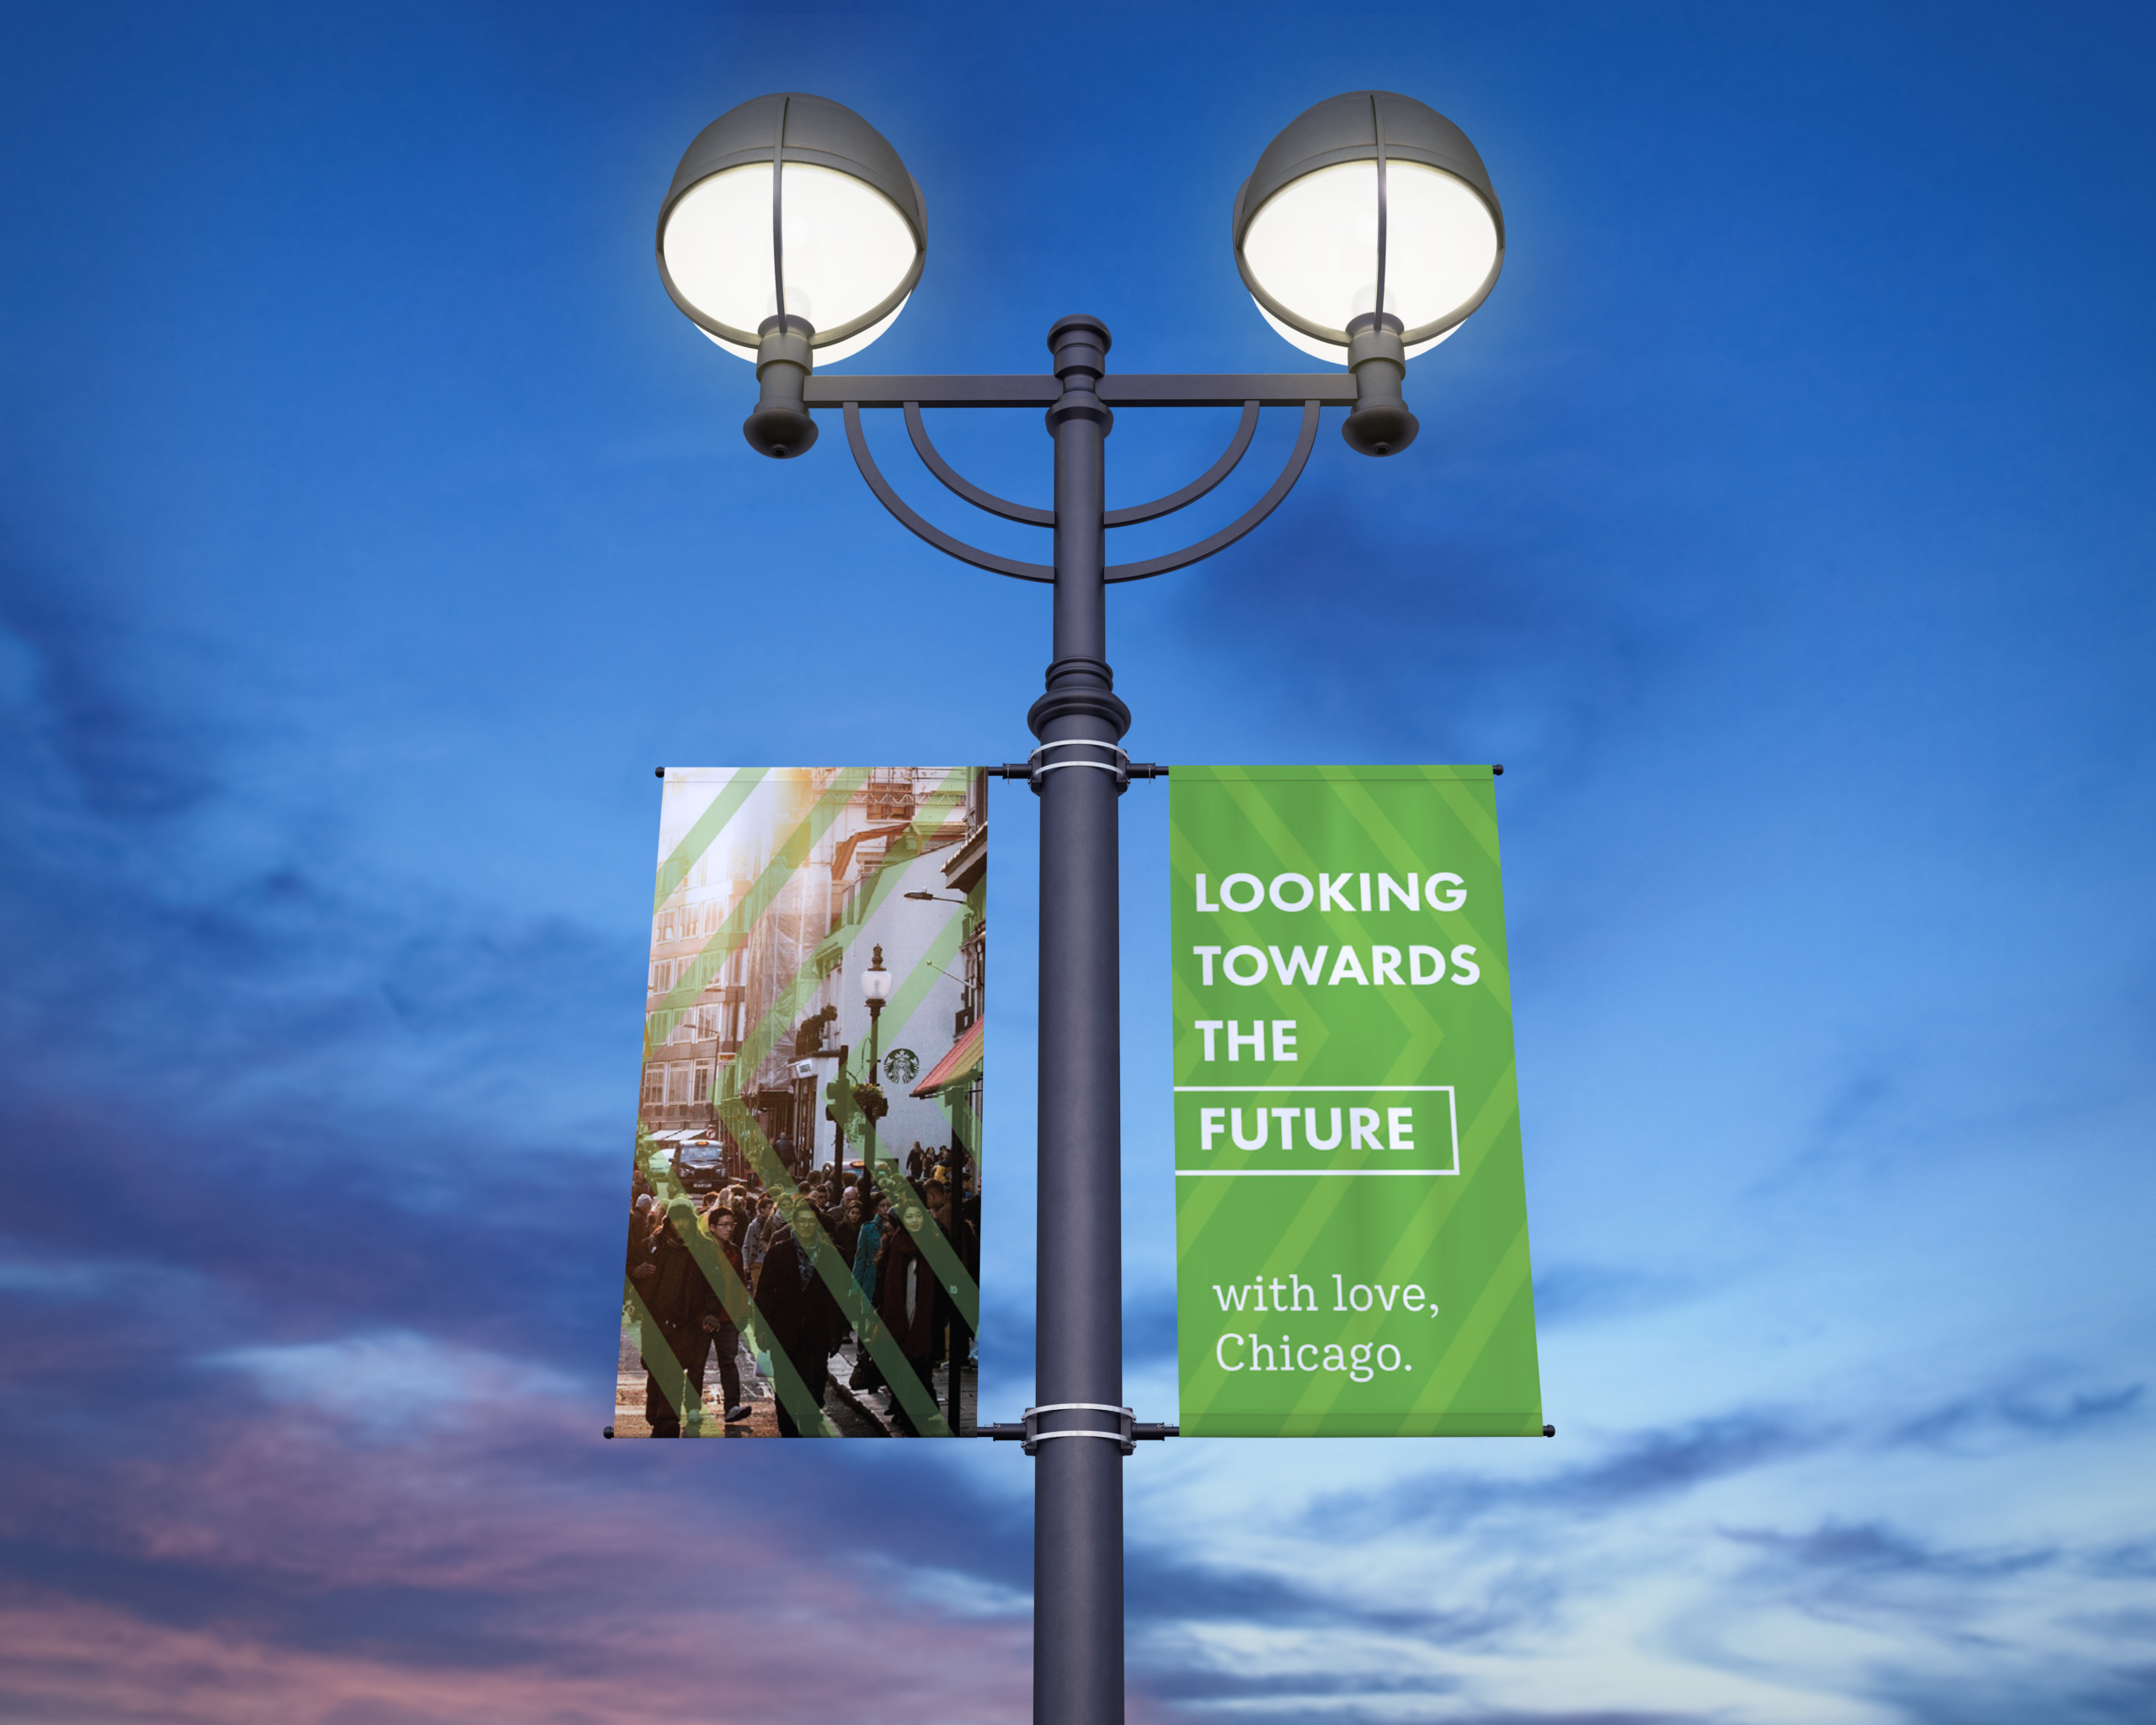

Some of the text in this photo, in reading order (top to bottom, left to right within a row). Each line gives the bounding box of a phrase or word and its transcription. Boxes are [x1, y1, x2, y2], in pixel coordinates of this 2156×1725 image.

[1195, 872, 1468, 913] LOOKING
[1193, 943, 1481, 986] TOWARDS
[1194, 1019, 1298, 1062] THE
[1200, 1107, 1415, 1151] FUTURE
[1212, 1274, 1439, 1318] with love,
[1215, 1332, 1412, 1383] Chicago.
